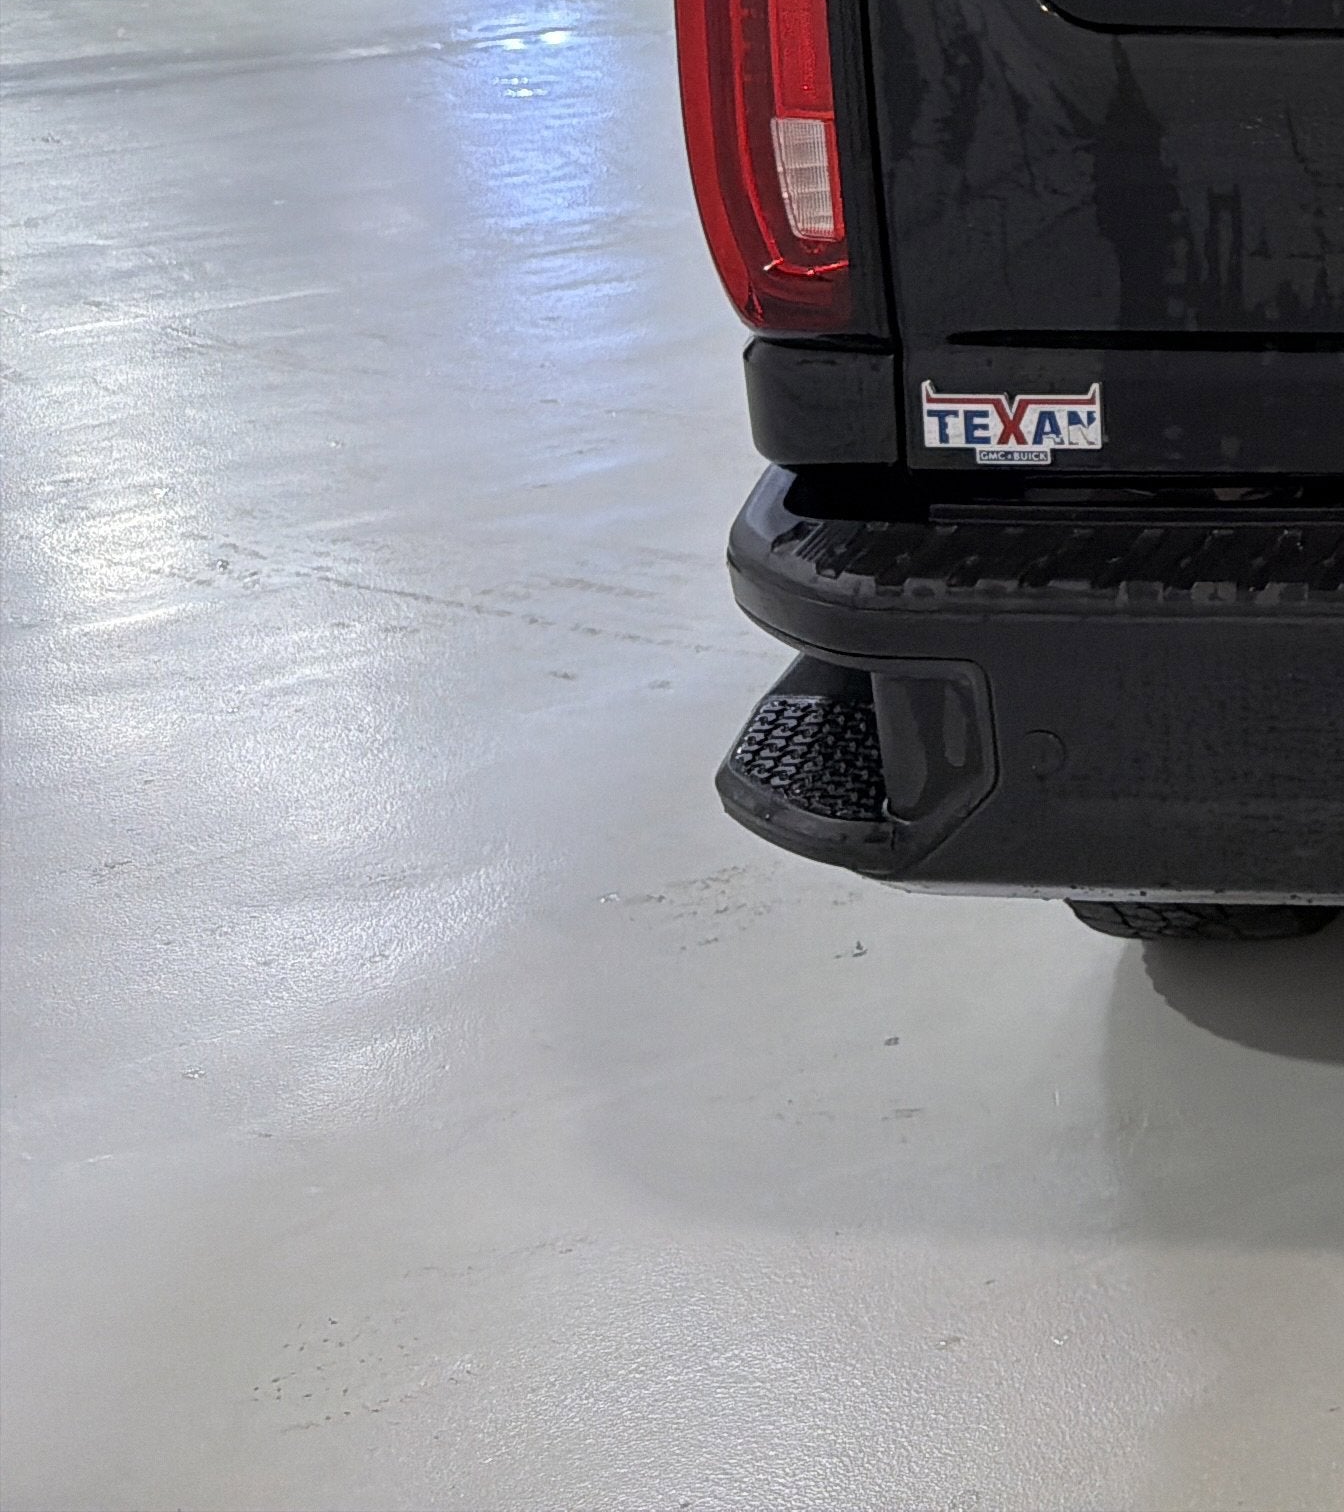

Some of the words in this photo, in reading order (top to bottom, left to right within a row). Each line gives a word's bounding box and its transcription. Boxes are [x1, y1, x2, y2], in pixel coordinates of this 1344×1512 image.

[925, 398, 1097, 446] TEXAN
[980, 451, 1006, 462] GMC
[1013, 451, 1048, 462] BUICK
